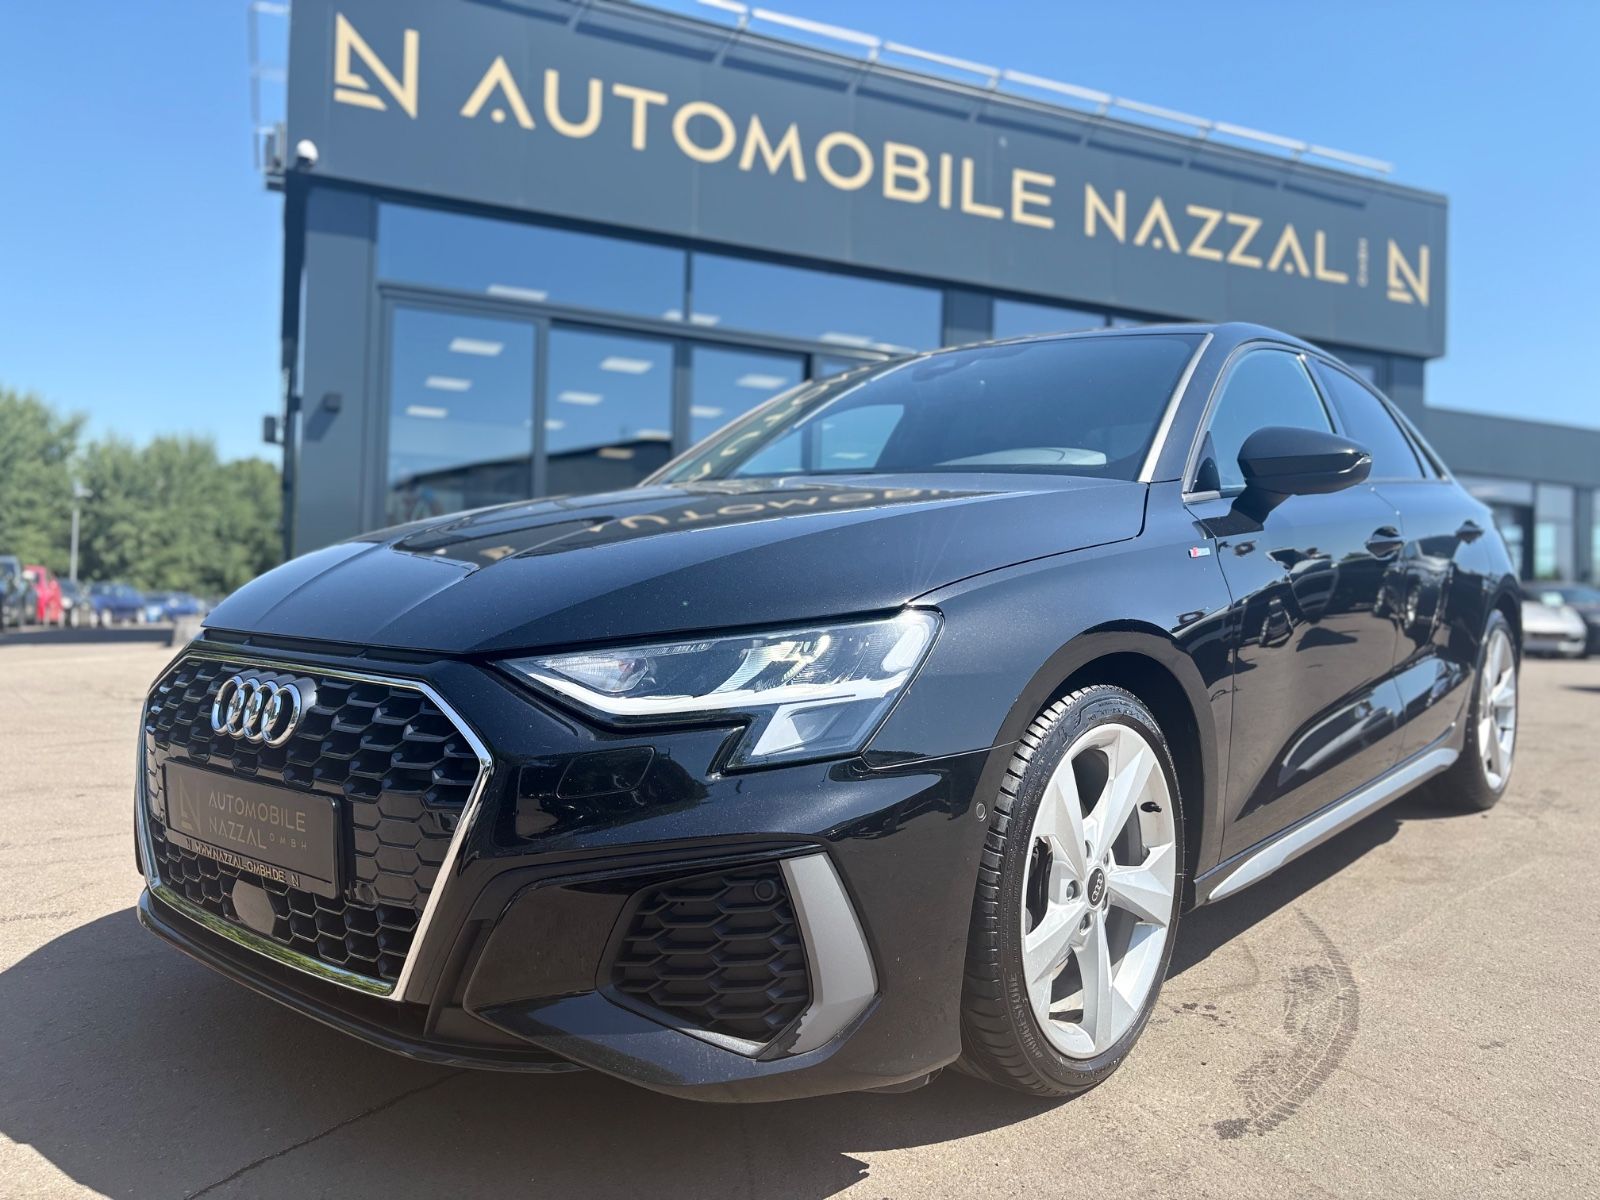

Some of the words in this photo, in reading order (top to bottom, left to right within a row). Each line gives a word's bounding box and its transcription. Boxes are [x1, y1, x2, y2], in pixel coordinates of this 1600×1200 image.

[460, 55, 1056, 230] AUTOMOBILE
[1083, 182, 1349, 285] NAZZAL
[208, 791, 306, 833] AUTOMOBILE
[208, 816, 267, 850] NAZZAL
